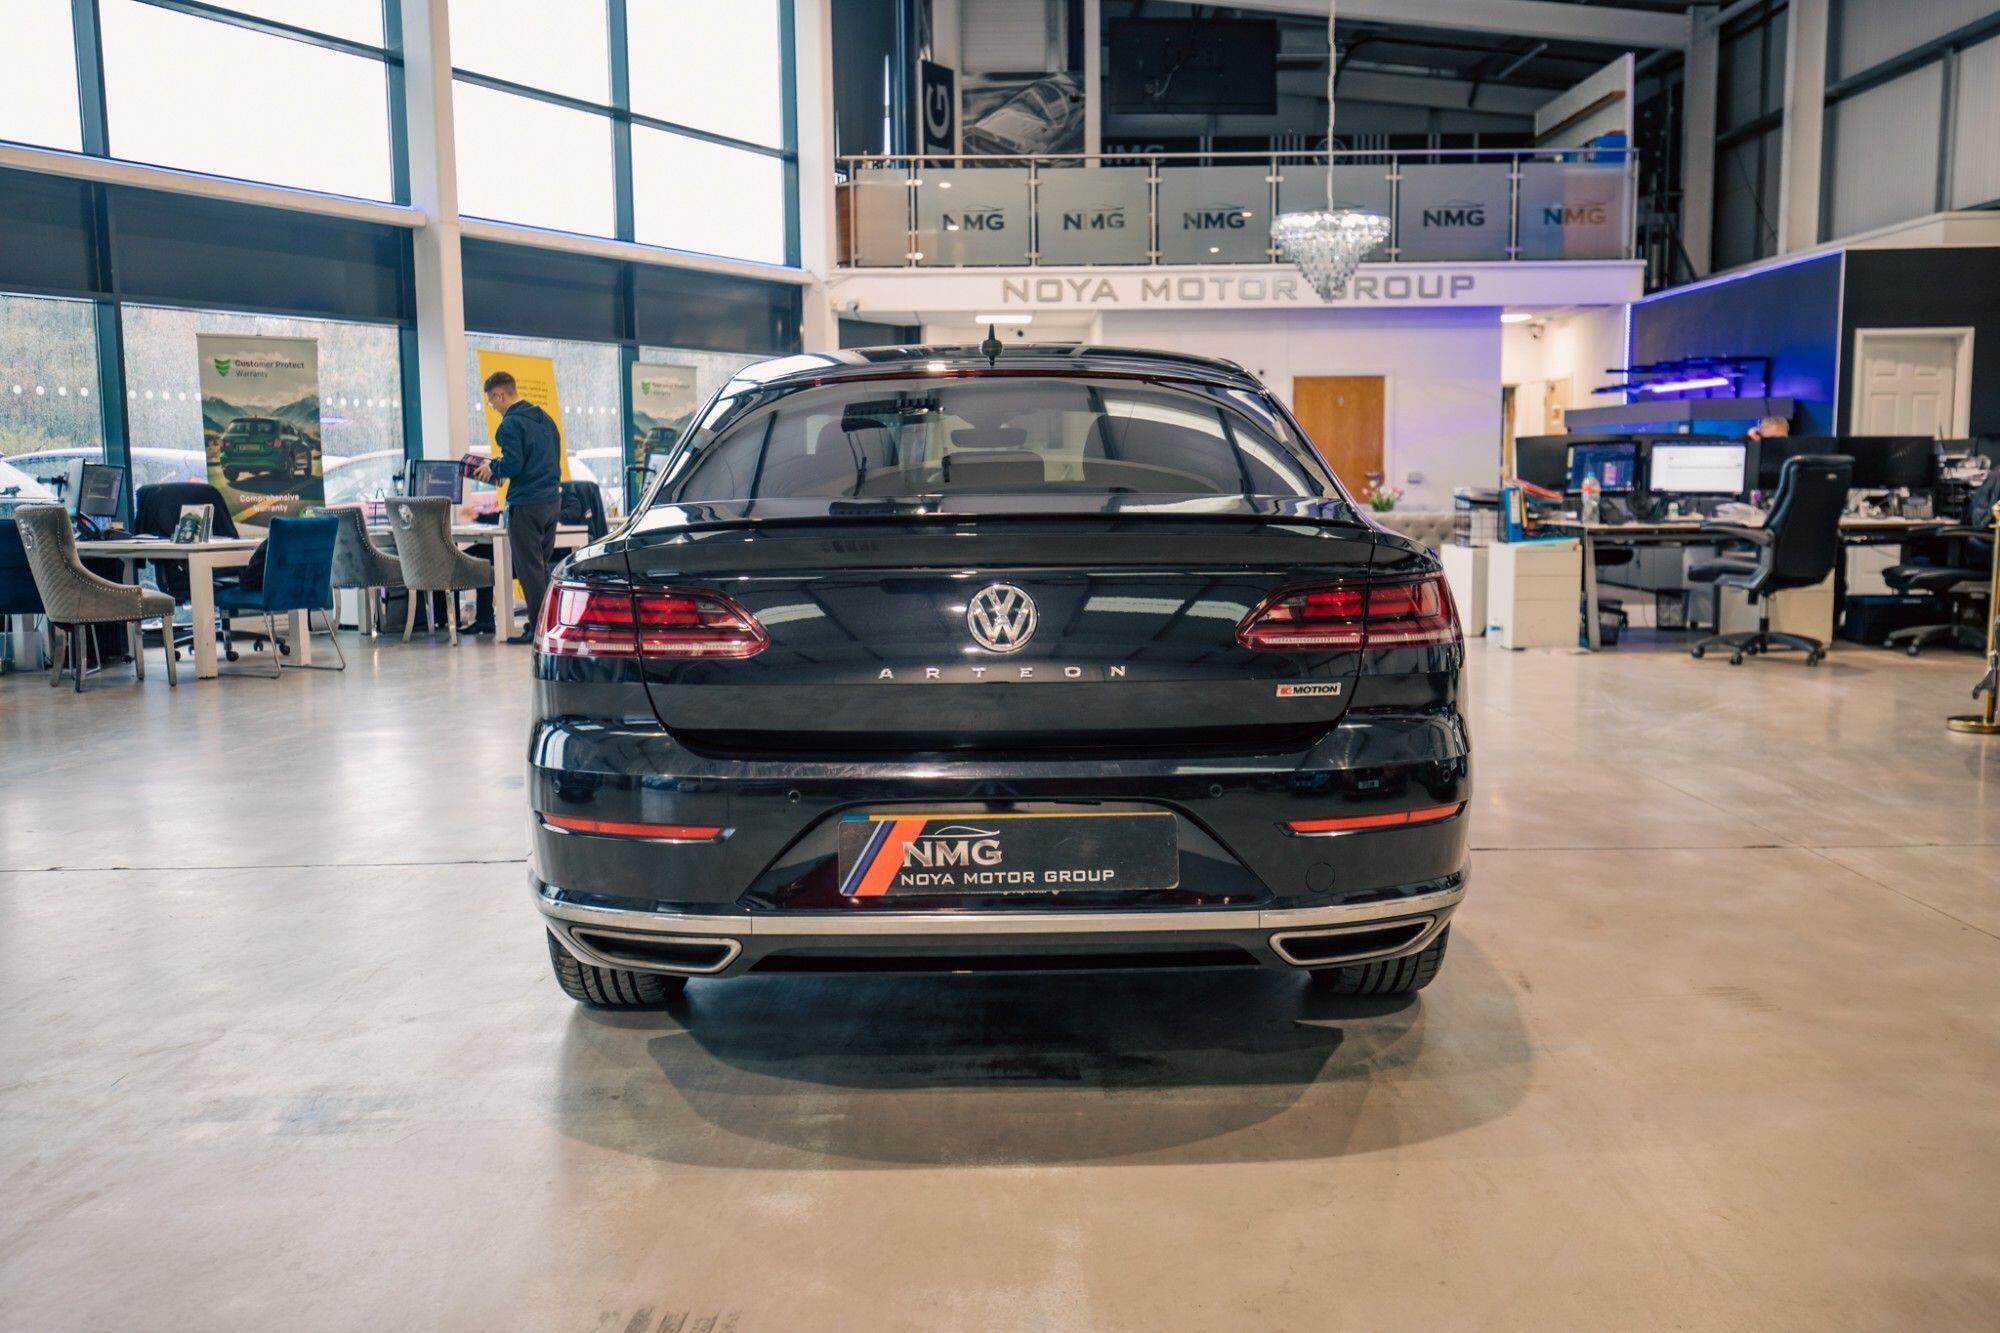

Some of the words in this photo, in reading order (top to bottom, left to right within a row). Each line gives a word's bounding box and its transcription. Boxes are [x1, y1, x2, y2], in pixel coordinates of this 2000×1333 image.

[1183, 211, 1246, 230] NMG
[1423, 209, 1486, 228] NMG
[1543, 207, 1607, 226] NMG
[1002, 277, 1120, 303] NOYA
[1142, 276, 1299, 302] MOTOR
[1332, 275, 1475, 300] ROUP
[235, 360, 274, 369] Customer
[275, 361, 305, 370] Protect
[236, 370, 268, 379] Warranty
[878, 665, 1126, 680] ARTEON
[902, 839, 1003, 868] NMG
[900, 872, 954, 886] NOYA
[963, 871, 1035, 885] MOTOR
[1044, 869, 1115, 883] GROUP
